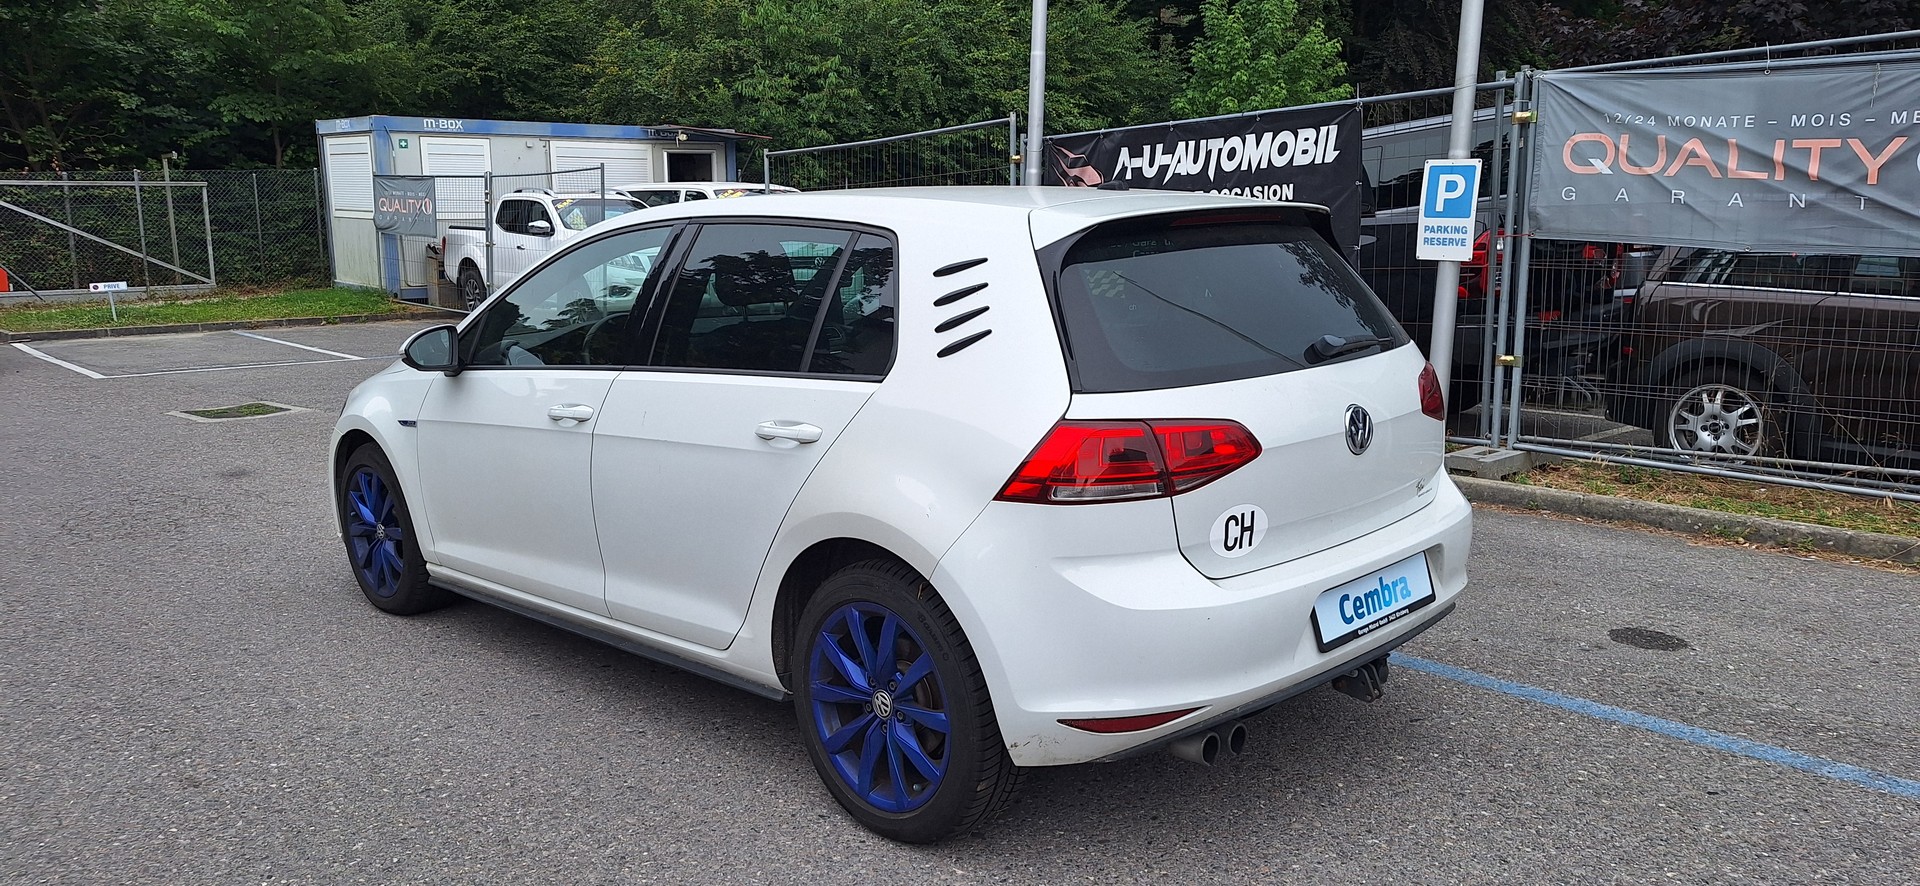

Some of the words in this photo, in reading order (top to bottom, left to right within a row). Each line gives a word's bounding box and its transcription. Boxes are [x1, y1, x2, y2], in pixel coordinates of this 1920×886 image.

[1603, 112, 1657, 127] 12/24
[1667, 115, 1755, 128] MONATE
[1789, 113, 1851, 128] MOIS
[1112, 124, 1341, 185] A-U-AUTOMOBIL
[1562, 132, 1908, 185] QUALITY
[379, 198, 422, 214] QUALITY
[1435, 173, 1466, 212] P
[1423, 225, 1468, 235] PARKING
[1423, 237, 1467, 247] RESERVE
[1223, 510, 1255, 551] CH
[1339, 576, 1412, 625] Cembra
